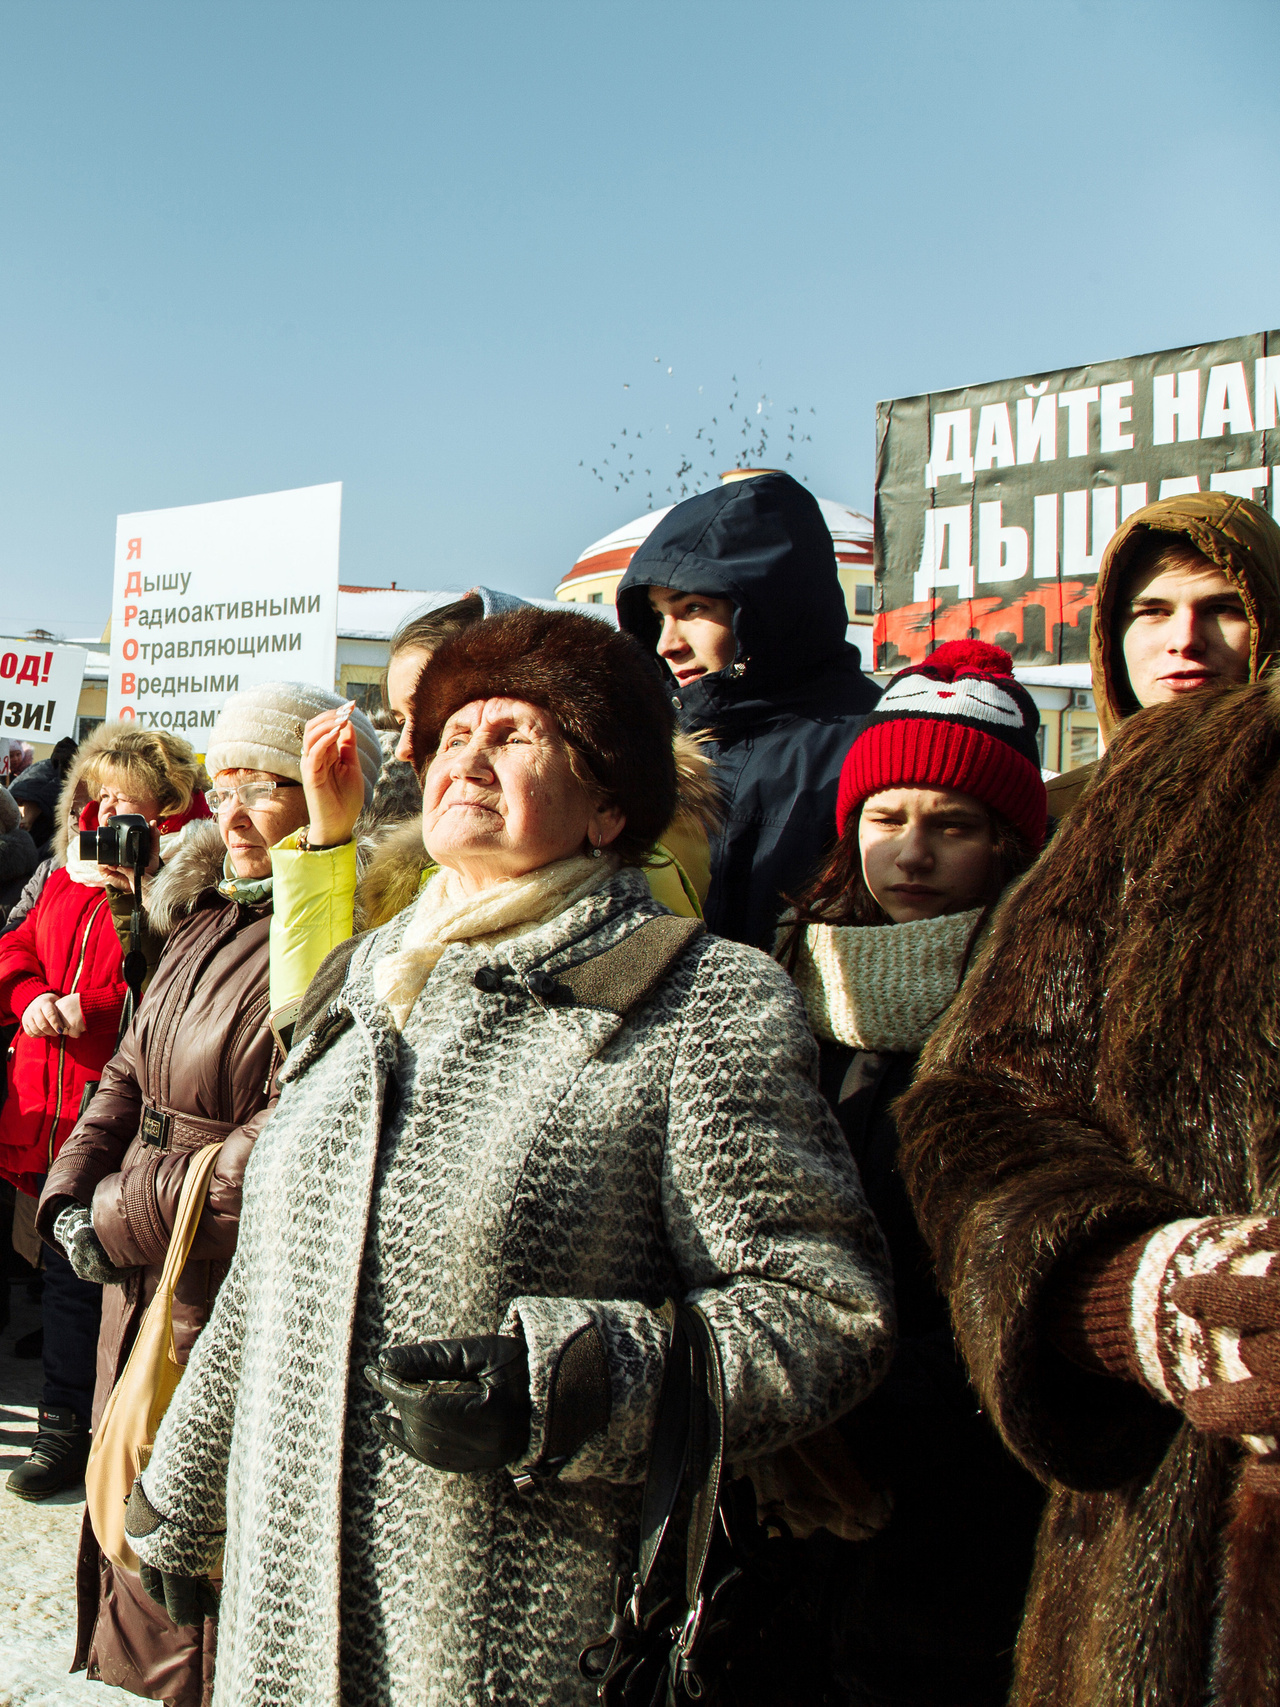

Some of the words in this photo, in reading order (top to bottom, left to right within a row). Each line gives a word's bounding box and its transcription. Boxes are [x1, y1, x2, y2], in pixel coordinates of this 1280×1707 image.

[925, 380, 1134, 488] ДАЙТЕ
[126, 537, 142, 560] Я
[124, 571, 192, 598] Дышу
[124, 594, 321, 630] Радиоактивными
[122, 633, 302, 665] Отравляющими
[120, 672, 240, 700] Вредными
[119, 705, 222, 732] Отходам
